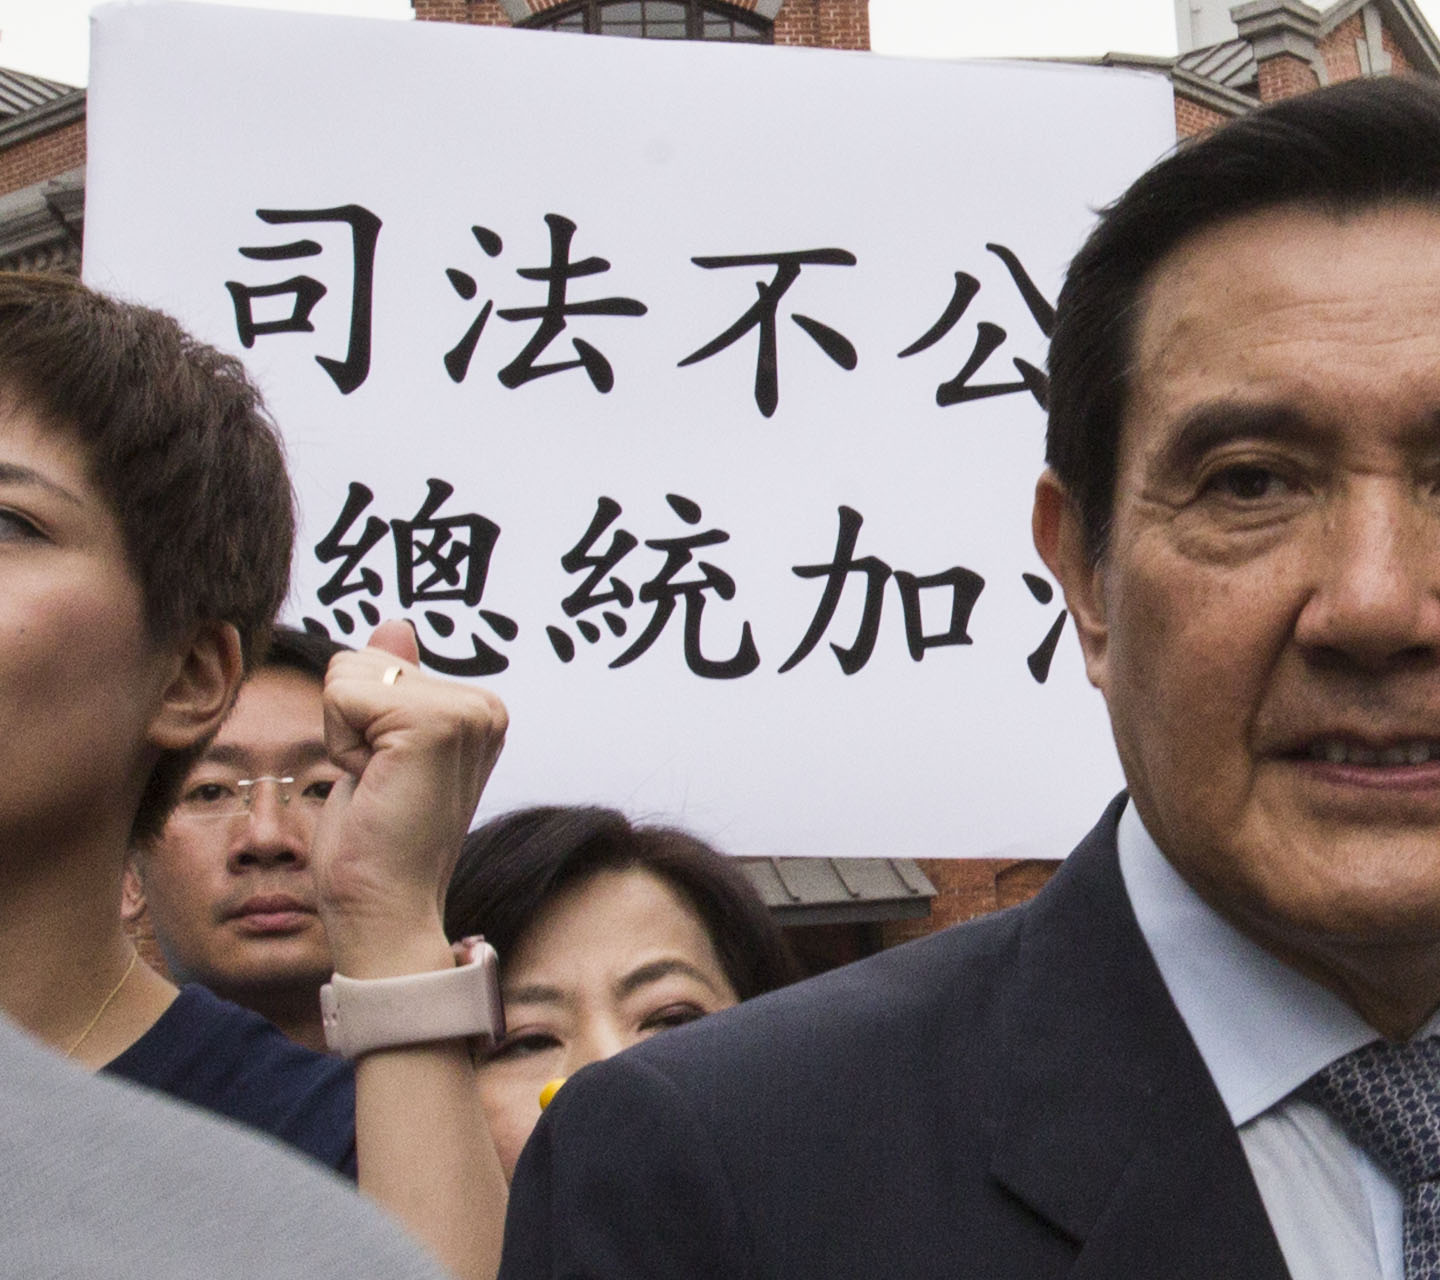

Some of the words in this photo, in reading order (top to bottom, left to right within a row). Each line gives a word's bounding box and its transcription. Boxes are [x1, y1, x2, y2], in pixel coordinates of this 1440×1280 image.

[225, 204, 1057, 417] 司法不公
[302, 478, 1068, 684] 總統加
